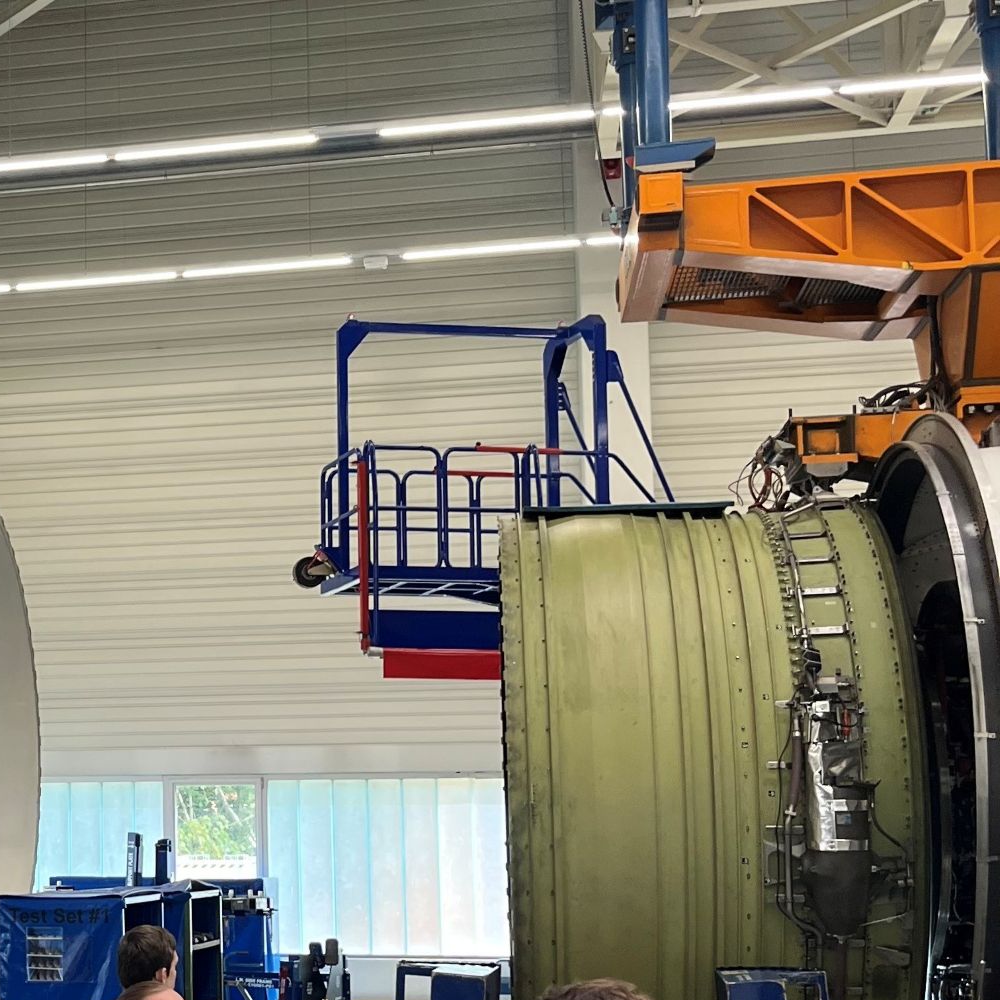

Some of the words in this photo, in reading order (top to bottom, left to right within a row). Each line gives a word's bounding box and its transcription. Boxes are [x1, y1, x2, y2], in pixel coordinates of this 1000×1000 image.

[9, 908, 47, 924] Test
[54, 908, 83, 924] Set
[88, 908, 109, 924] #1
